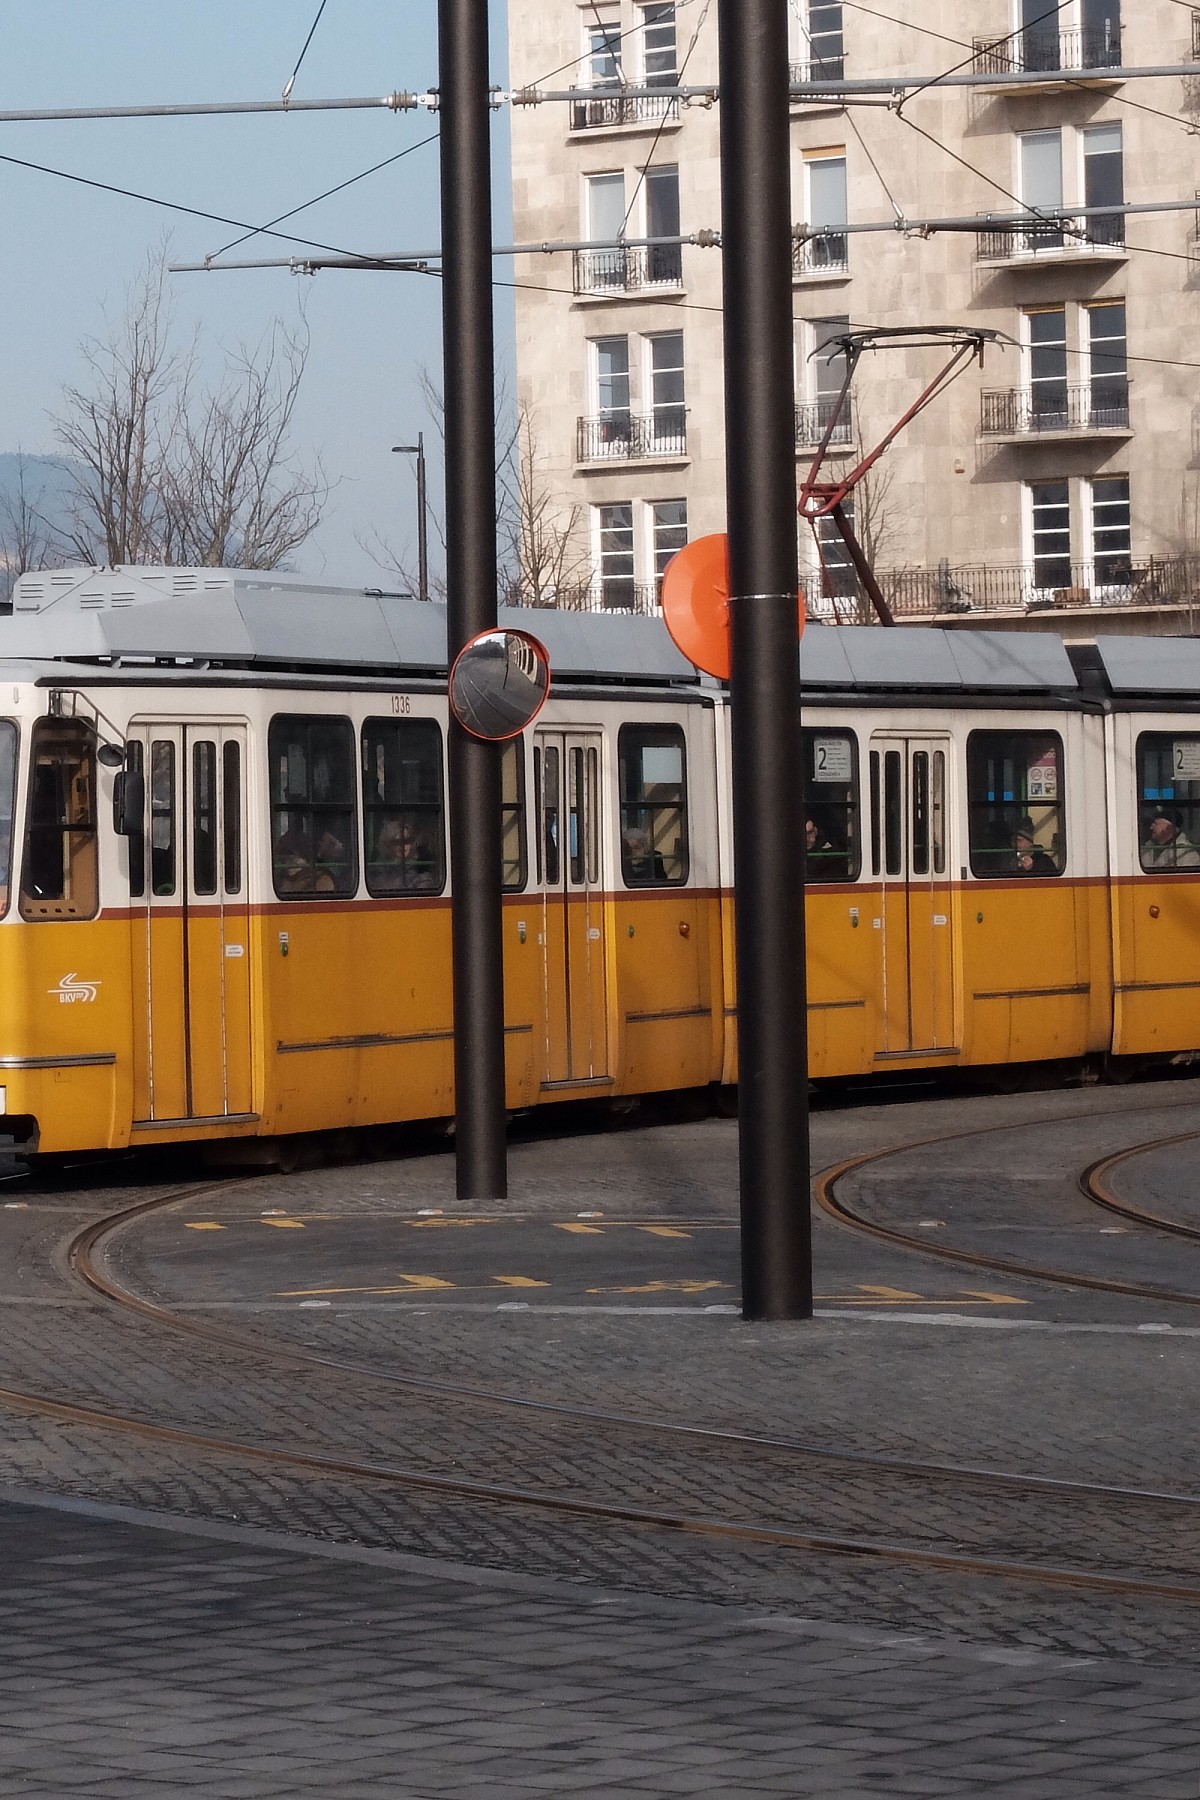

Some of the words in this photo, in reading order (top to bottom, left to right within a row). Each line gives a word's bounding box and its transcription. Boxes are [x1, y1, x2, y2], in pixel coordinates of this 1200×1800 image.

[391, 695, 411, 714] 1336
[818, 746, 827, 770] 2
[1176, 748, 1184, 769] 2
[59, 992, 76, 1003] BKV
